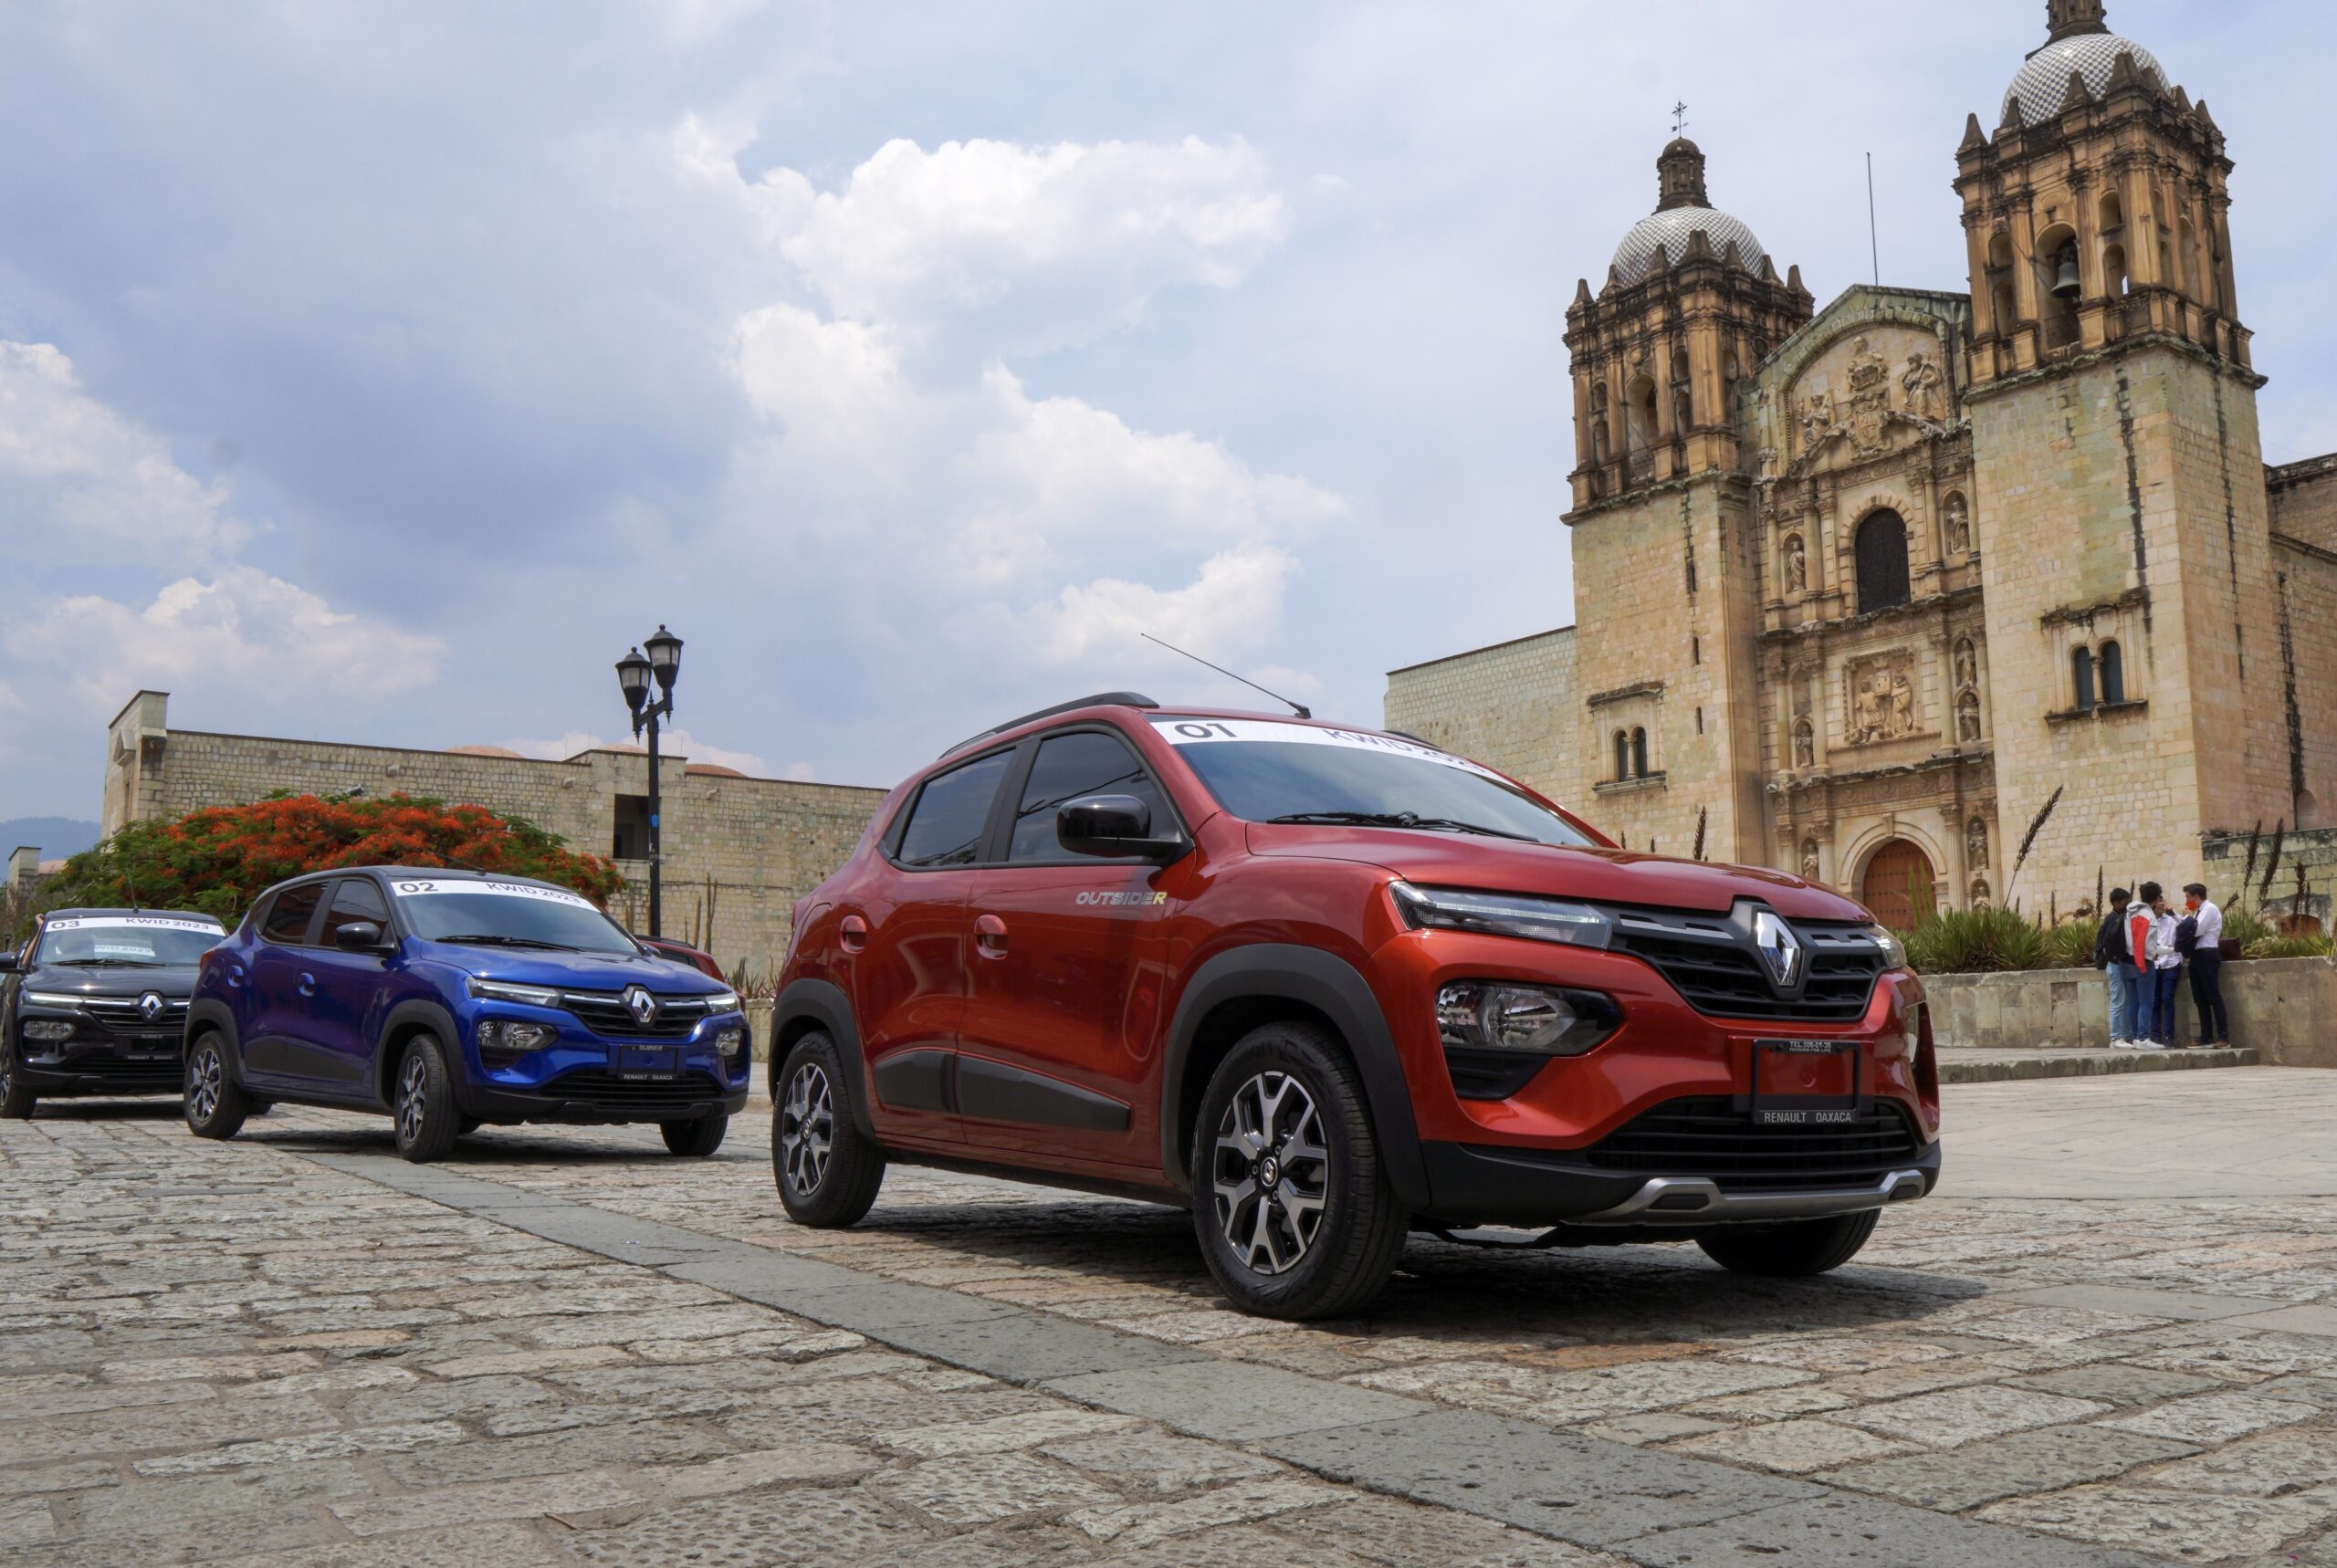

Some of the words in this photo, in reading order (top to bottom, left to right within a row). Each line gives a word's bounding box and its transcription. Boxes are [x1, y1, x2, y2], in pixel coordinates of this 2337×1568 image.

[1174, 723, 1238, 738] 01
[1322, 729, 1413, 751] KWID
[399, 882, 438, 893] 02
[487, 883, 536, 894] KWID
[538, 890, 581, 904] 2023
[1075, 891, 1168, 905] OUTSIDER
[51, 920, 80, 929] 03
[125, 917, 169, 925] KWID
[173, 920, 210, 930] 2023
[1764, 1112, 1807, 1123] RENAULT
[1816, 1112, 1851, 1123] OAXACA
